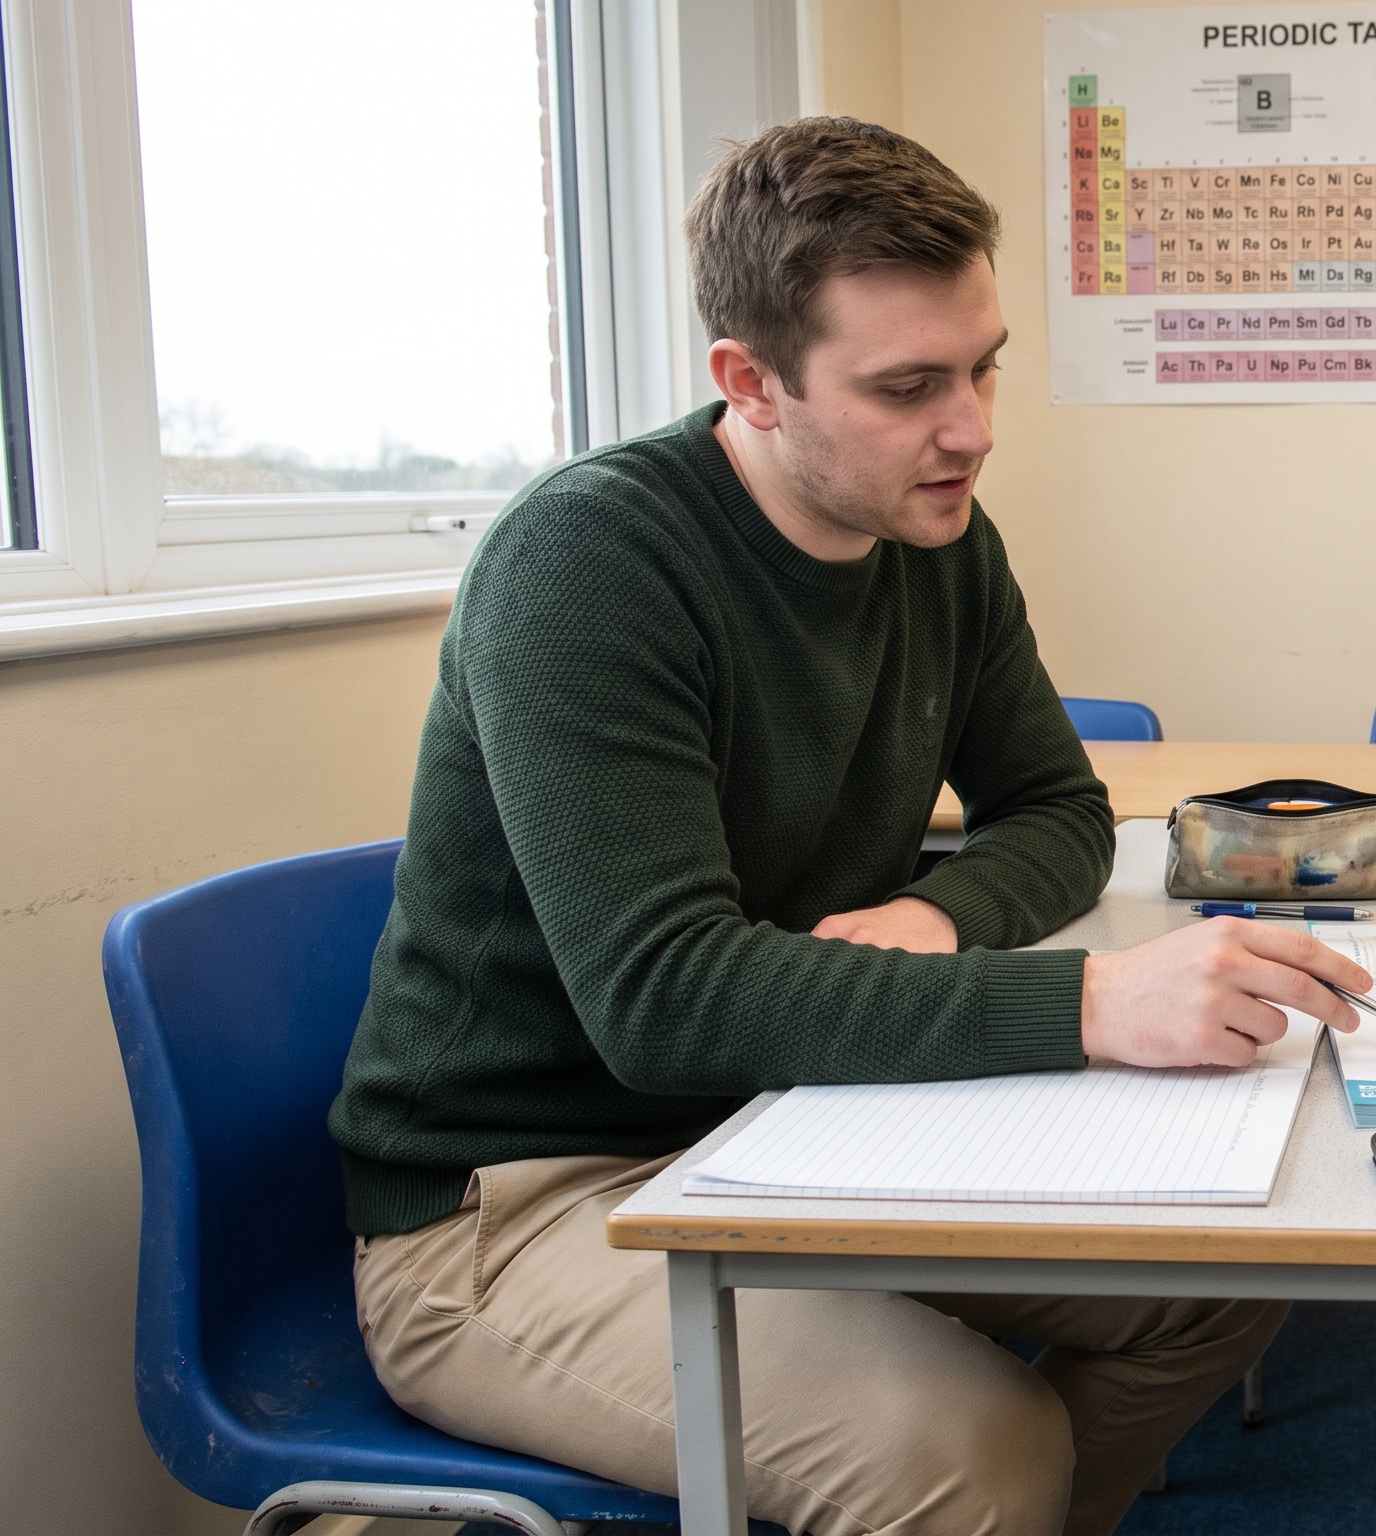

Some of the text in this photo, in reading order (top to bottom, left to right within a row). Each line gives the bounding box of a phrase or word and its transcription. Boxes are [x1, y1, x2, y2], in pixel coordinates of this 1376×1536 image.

[1203, 22, 1337, 49] PERIODIC
[1078, 84, 1087, 95] H
[1257, 90, 1272, 110] B
[1102, 115, 1119, 127] Be
[1101, 147, 1120, 161] Mg
[1080, 179, 1088, 190] K
[1102, 178, 1120, 190] Ca
[1131, 177, 1147, 190] Sc
[1190, 176, 1199, 188] V
[1215, 176, 1230, 188] Cr
[1241, 176, 1260, 186] Mn
[1271, 174, 1285, 186] Fe
[1297, 174, 1315, 186] Co
[1354, 173, 1372, 185] Cu
[1076, 209, 1094, 221] Rb
[1135, 209, 1144, 220] Y
[1160, 208, 1174, 220] Zr
[1186, 209, 1204, 219] Nb
[1213, 208, 1232, 219] Mo
[1244, 206, 1258, 218] Tc
[1270, 206, 1287, 218] Ru
[1297, 206, 1315, 217] Rh
[1326, 206, 1343, 217] Pd
[1354, 205, 1372, 220] Ag
[1161, 240, 1175, 251] Hf
[1188, 239, 1204, 251] Ta
[1217, 239, 1229, 250] W
[1270, 238, 1287, 250] Os
[1328, 237, 1341, 248] Pt
[1354, 237, 1372, 248] Au
[1078, 272, 1092, 283] Fr
[1162, 271, 1176, 282] Rf
[1187, 271, 1205, 282] Db
[1215, 270, 1232, 285] Sg
[1243, 270, 1259, 281] Bh
[1271, 270, 1287, 281] Hs
[1355, 269, 1372, 283] Rg
[1161, 319, 1176, 330] Lu
[1217, 318, 1231, 329] Pr
[1243, 318, 1260, 328] Nd
[1269, 317, 1290, 328] Pm
[1297, 316, 1317, 328] Sm
[1326, 316, 1344, 328] Gd
[1355, 316, 1371, 327] Tb
[1161, 361, 1177, 372] Ac
[1189, 360, 1205, 371] Th
[1216, 359, 1232, 371] Pa
[1247, 360, 1256, 371] U
[1271, 360, 1289, 373] Np
[1299, 359, 1315, 370] Pu
[1324, 359, 1346, 370] Cm
[1355, 359, 1371, 370] Bk
